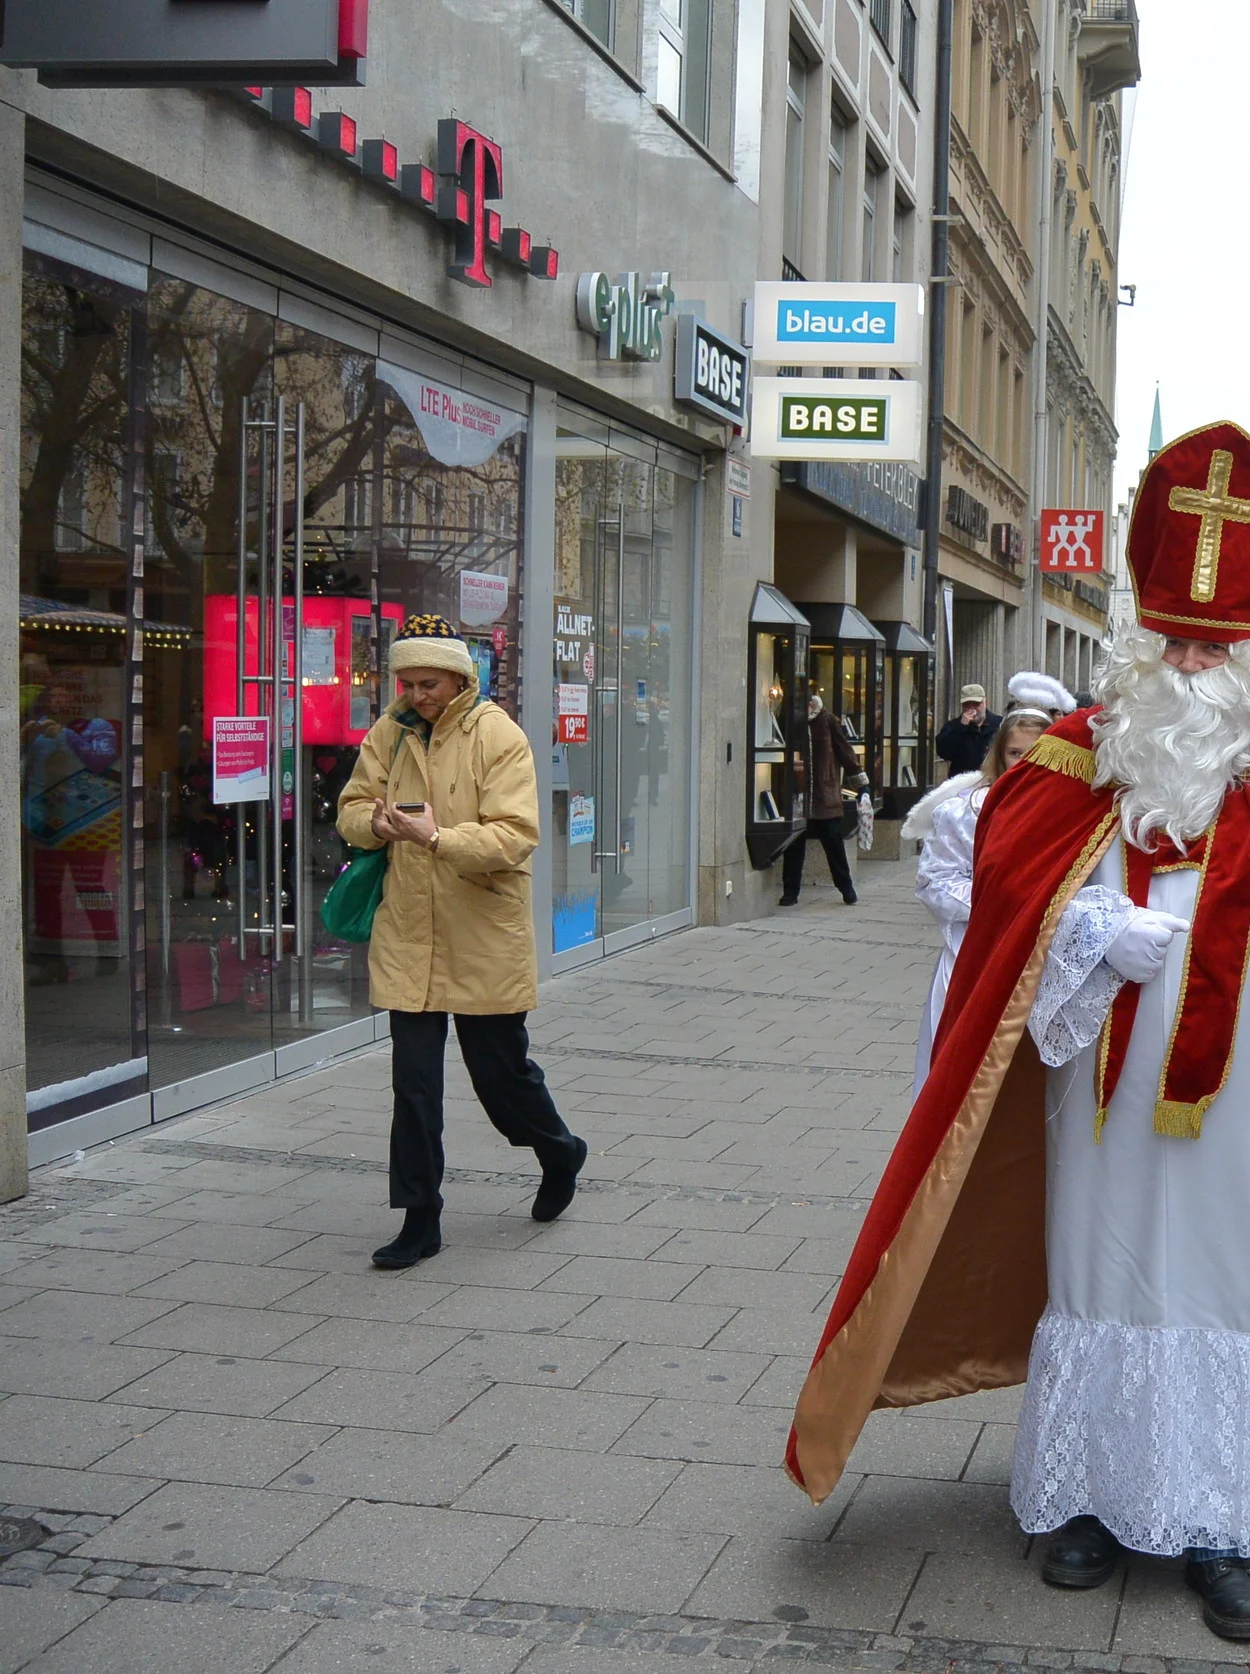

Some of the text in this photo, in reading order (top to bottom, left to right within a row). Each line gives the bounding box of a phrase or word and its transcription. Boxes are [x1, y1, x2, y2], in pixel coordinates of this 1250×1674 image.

[785, 309, 886, 335] blau.de
[697, 336, 742, 408] BASE
[420, 385, 462, 425] LTE Plus
[477, 406, 501, 425] SCHNELLER
[789, 404, 878, 433] BASE
[556, 613, 596, 637] ALLNET-
[556, 640, 581, 663] FLAT
[216, 721, 257, 731] STARKE VORTEILE
[216, 731, 265, 742] FÜR SELBSTSTÄNDIGE
